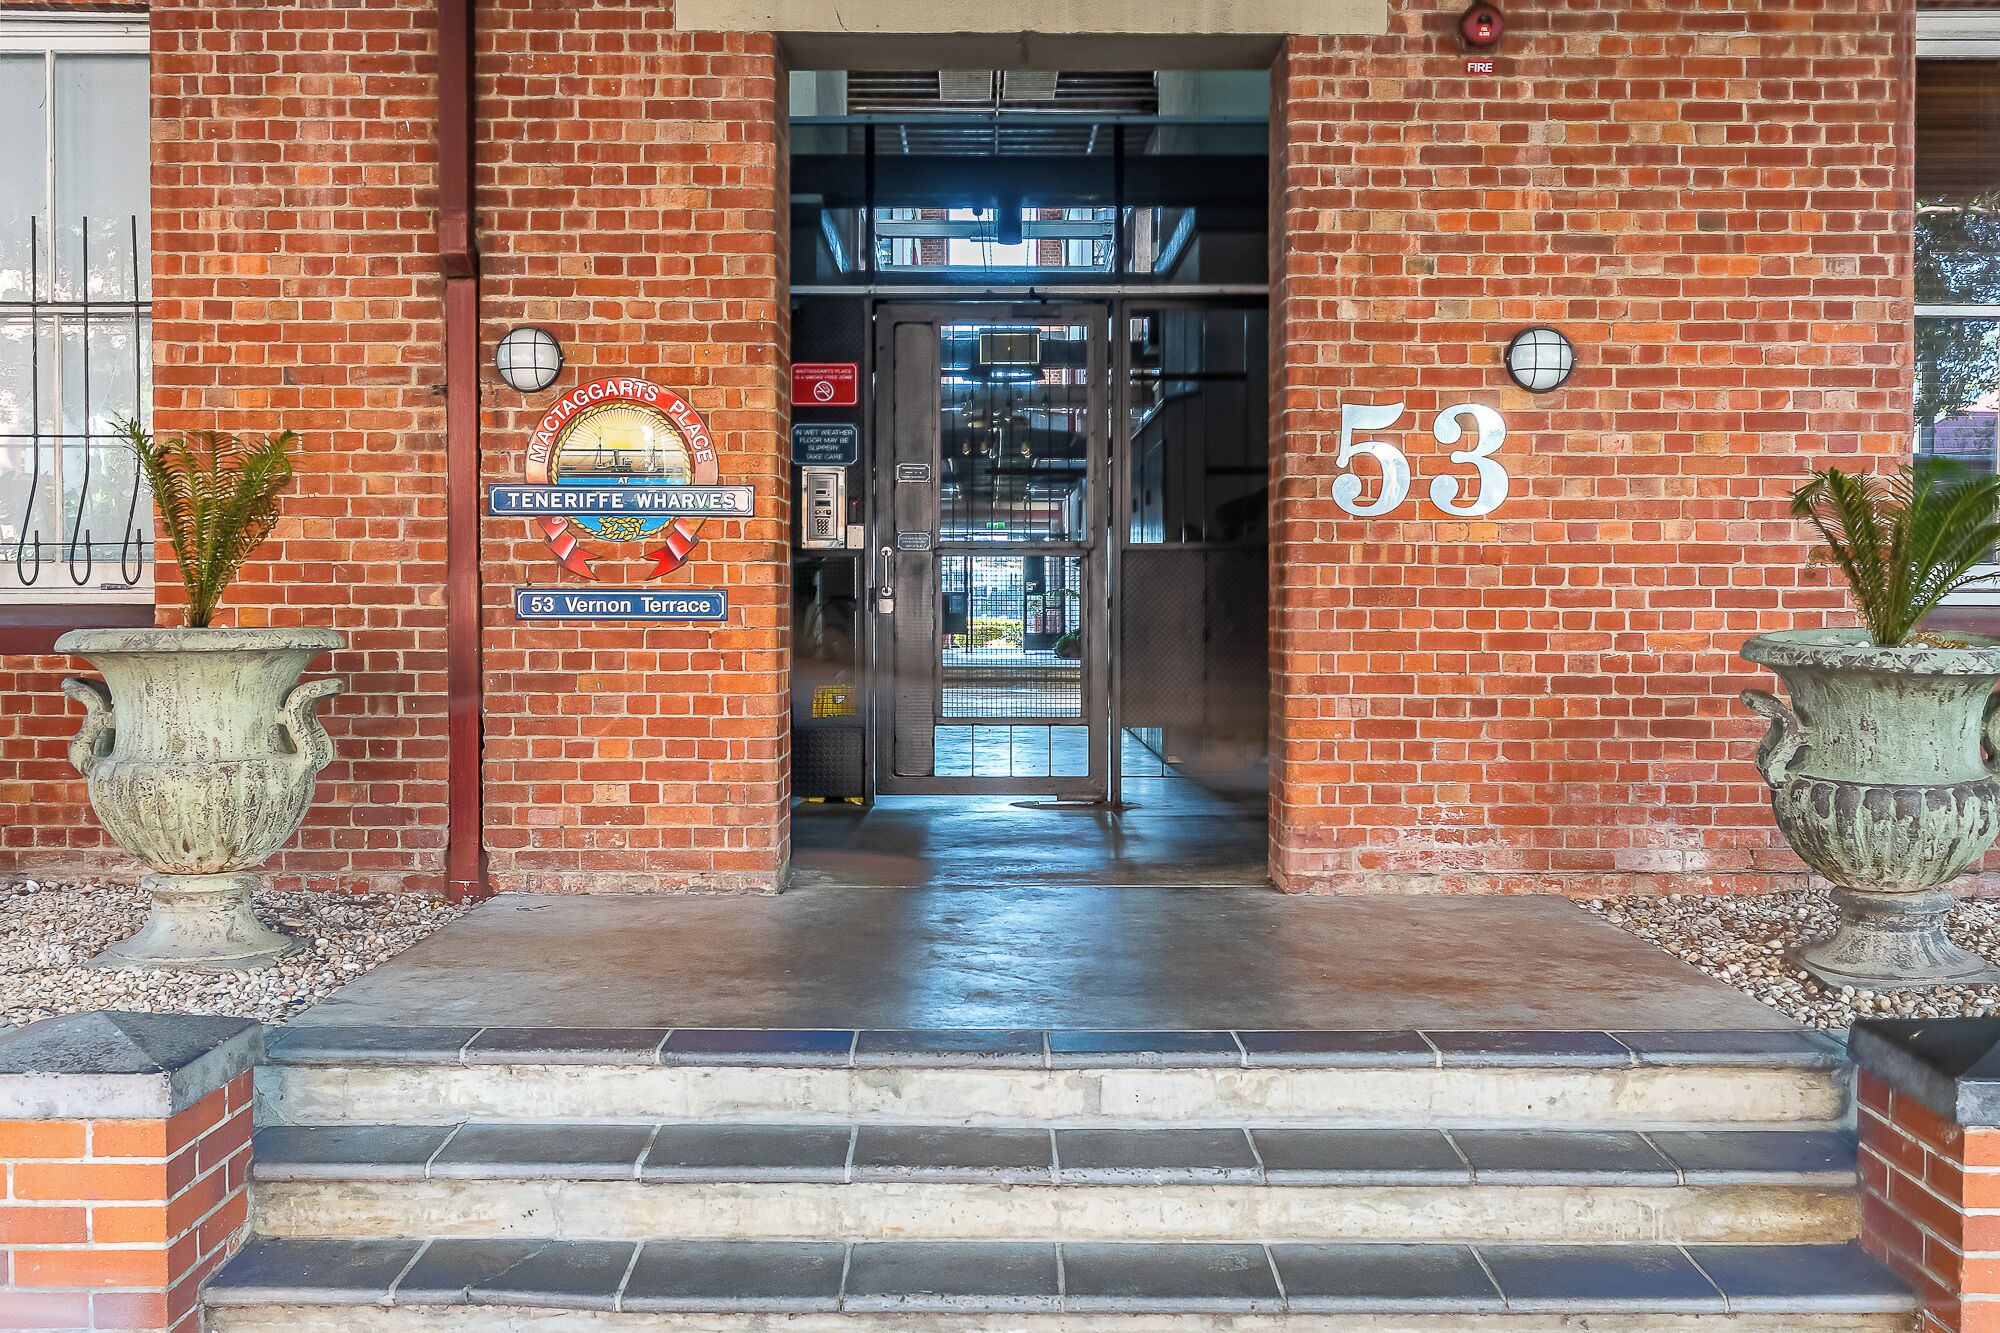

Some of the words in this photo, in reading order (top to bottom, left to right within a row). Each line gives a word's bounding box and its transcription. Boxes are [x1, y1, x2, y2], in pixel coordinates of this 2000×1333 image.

[1467, 62, 1493, 73] FIRE
[529, 379, 660, 463] MACTAGGARTS
[668, 400, 714, 464] PLACE
[1331, 401, 1510, 517] 53
[617, 476, 629, 485] AT
[507, 492, 624, 509] TENERIFFE
[636, 492, 736, 510] WHARVES
[530, 596, 555, 613] 53
[564, 596, 631, 613] Vernon
[640, 596, 711, 613] Terrace
